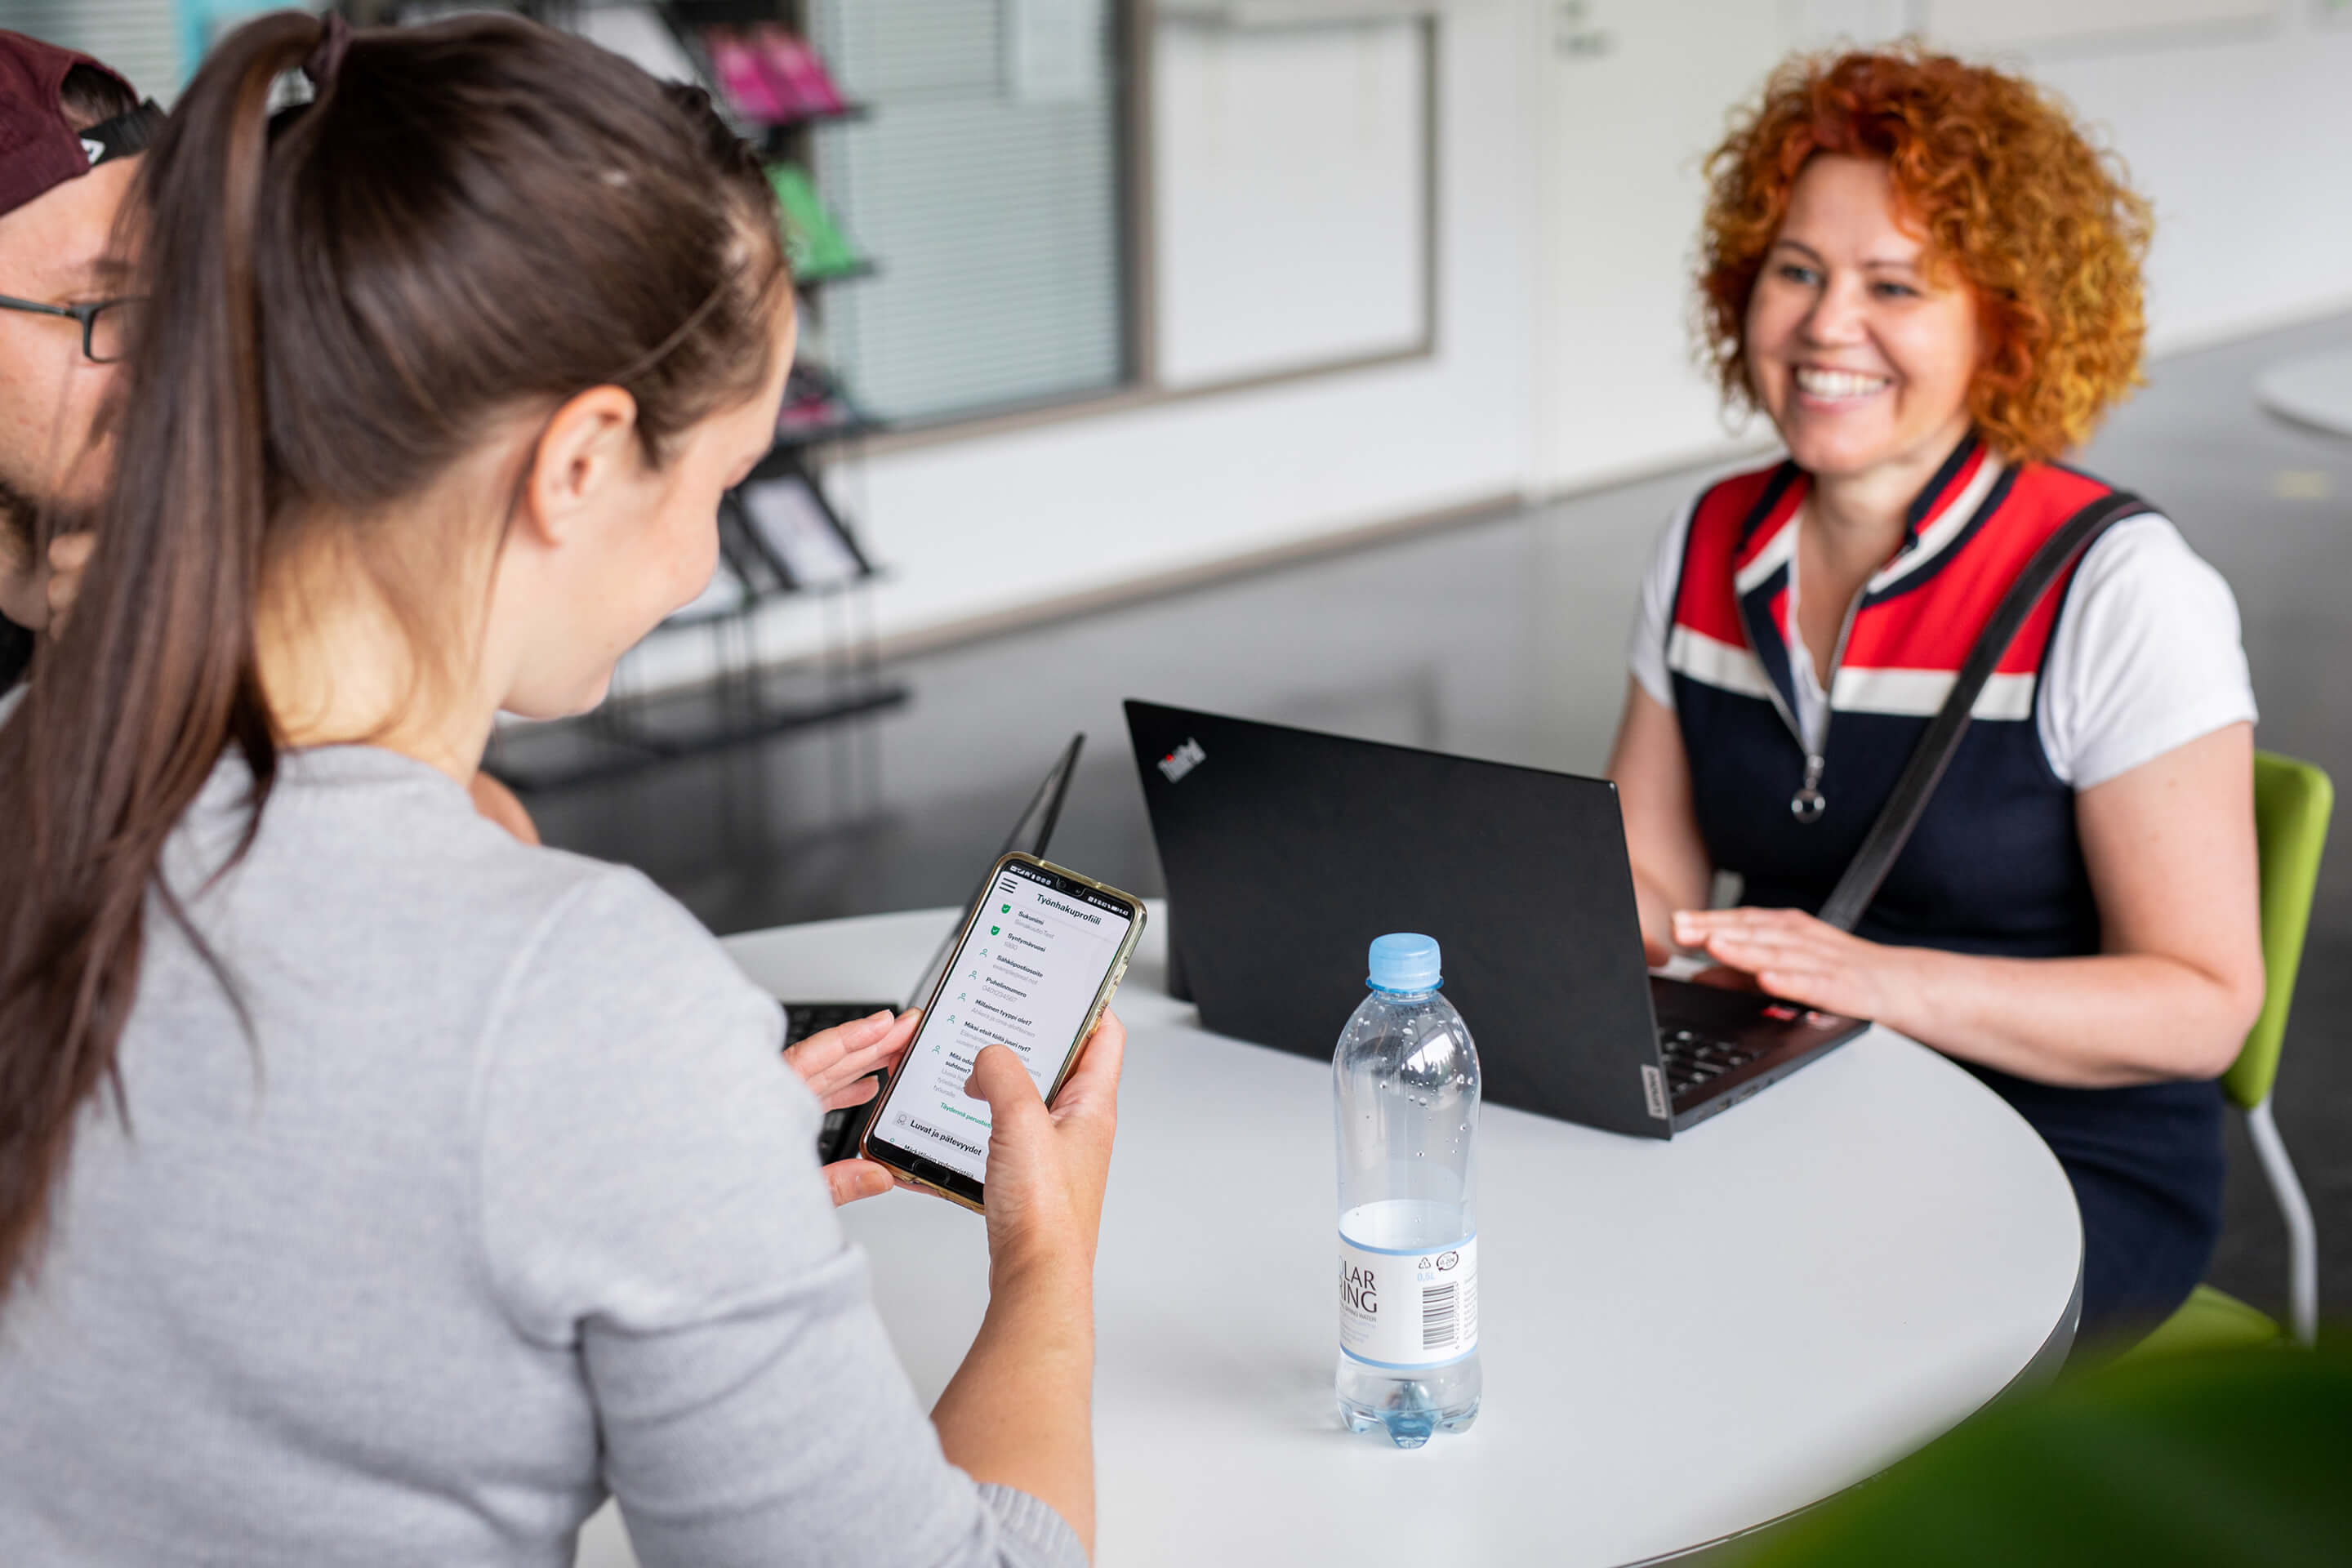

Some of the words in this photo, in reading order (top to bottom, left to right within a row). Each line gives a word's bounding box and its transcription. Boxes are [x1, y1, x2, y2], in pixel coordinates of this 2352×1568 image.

[1018, 911, 1045, 925] Sukunimi
[1036, 893, 1102, 925] Työnhakuprofiili
[1007, 933, 1046, 952] Syntymävuosi
[996, 955, 1044, 978] Sähköpostiosoite
[986, 977, 1027, 998] Puhelinnumero
[975, 999, 1000, 1013] Millainen
[1000, 1009, 1018, 1021] tyyppi
[1017, 1017, 1032, 1027] olet?
[964, 1021, 980, 1031] Miksi
[979, 1027, 992, 1037] etsit
[1004, 1038, 1018, 1048] juuri
[1018, 1044, 1031, 1053] nyt?
[945, 1061, 971, 1074] suhteen?
[940, 1102, 966, 1117] Täydennä
[910, 1120, 932, 1134] Luvat
[930, 1129, 940, 1138] ja
[939, 1134, 982, 1156] pätevyydet
